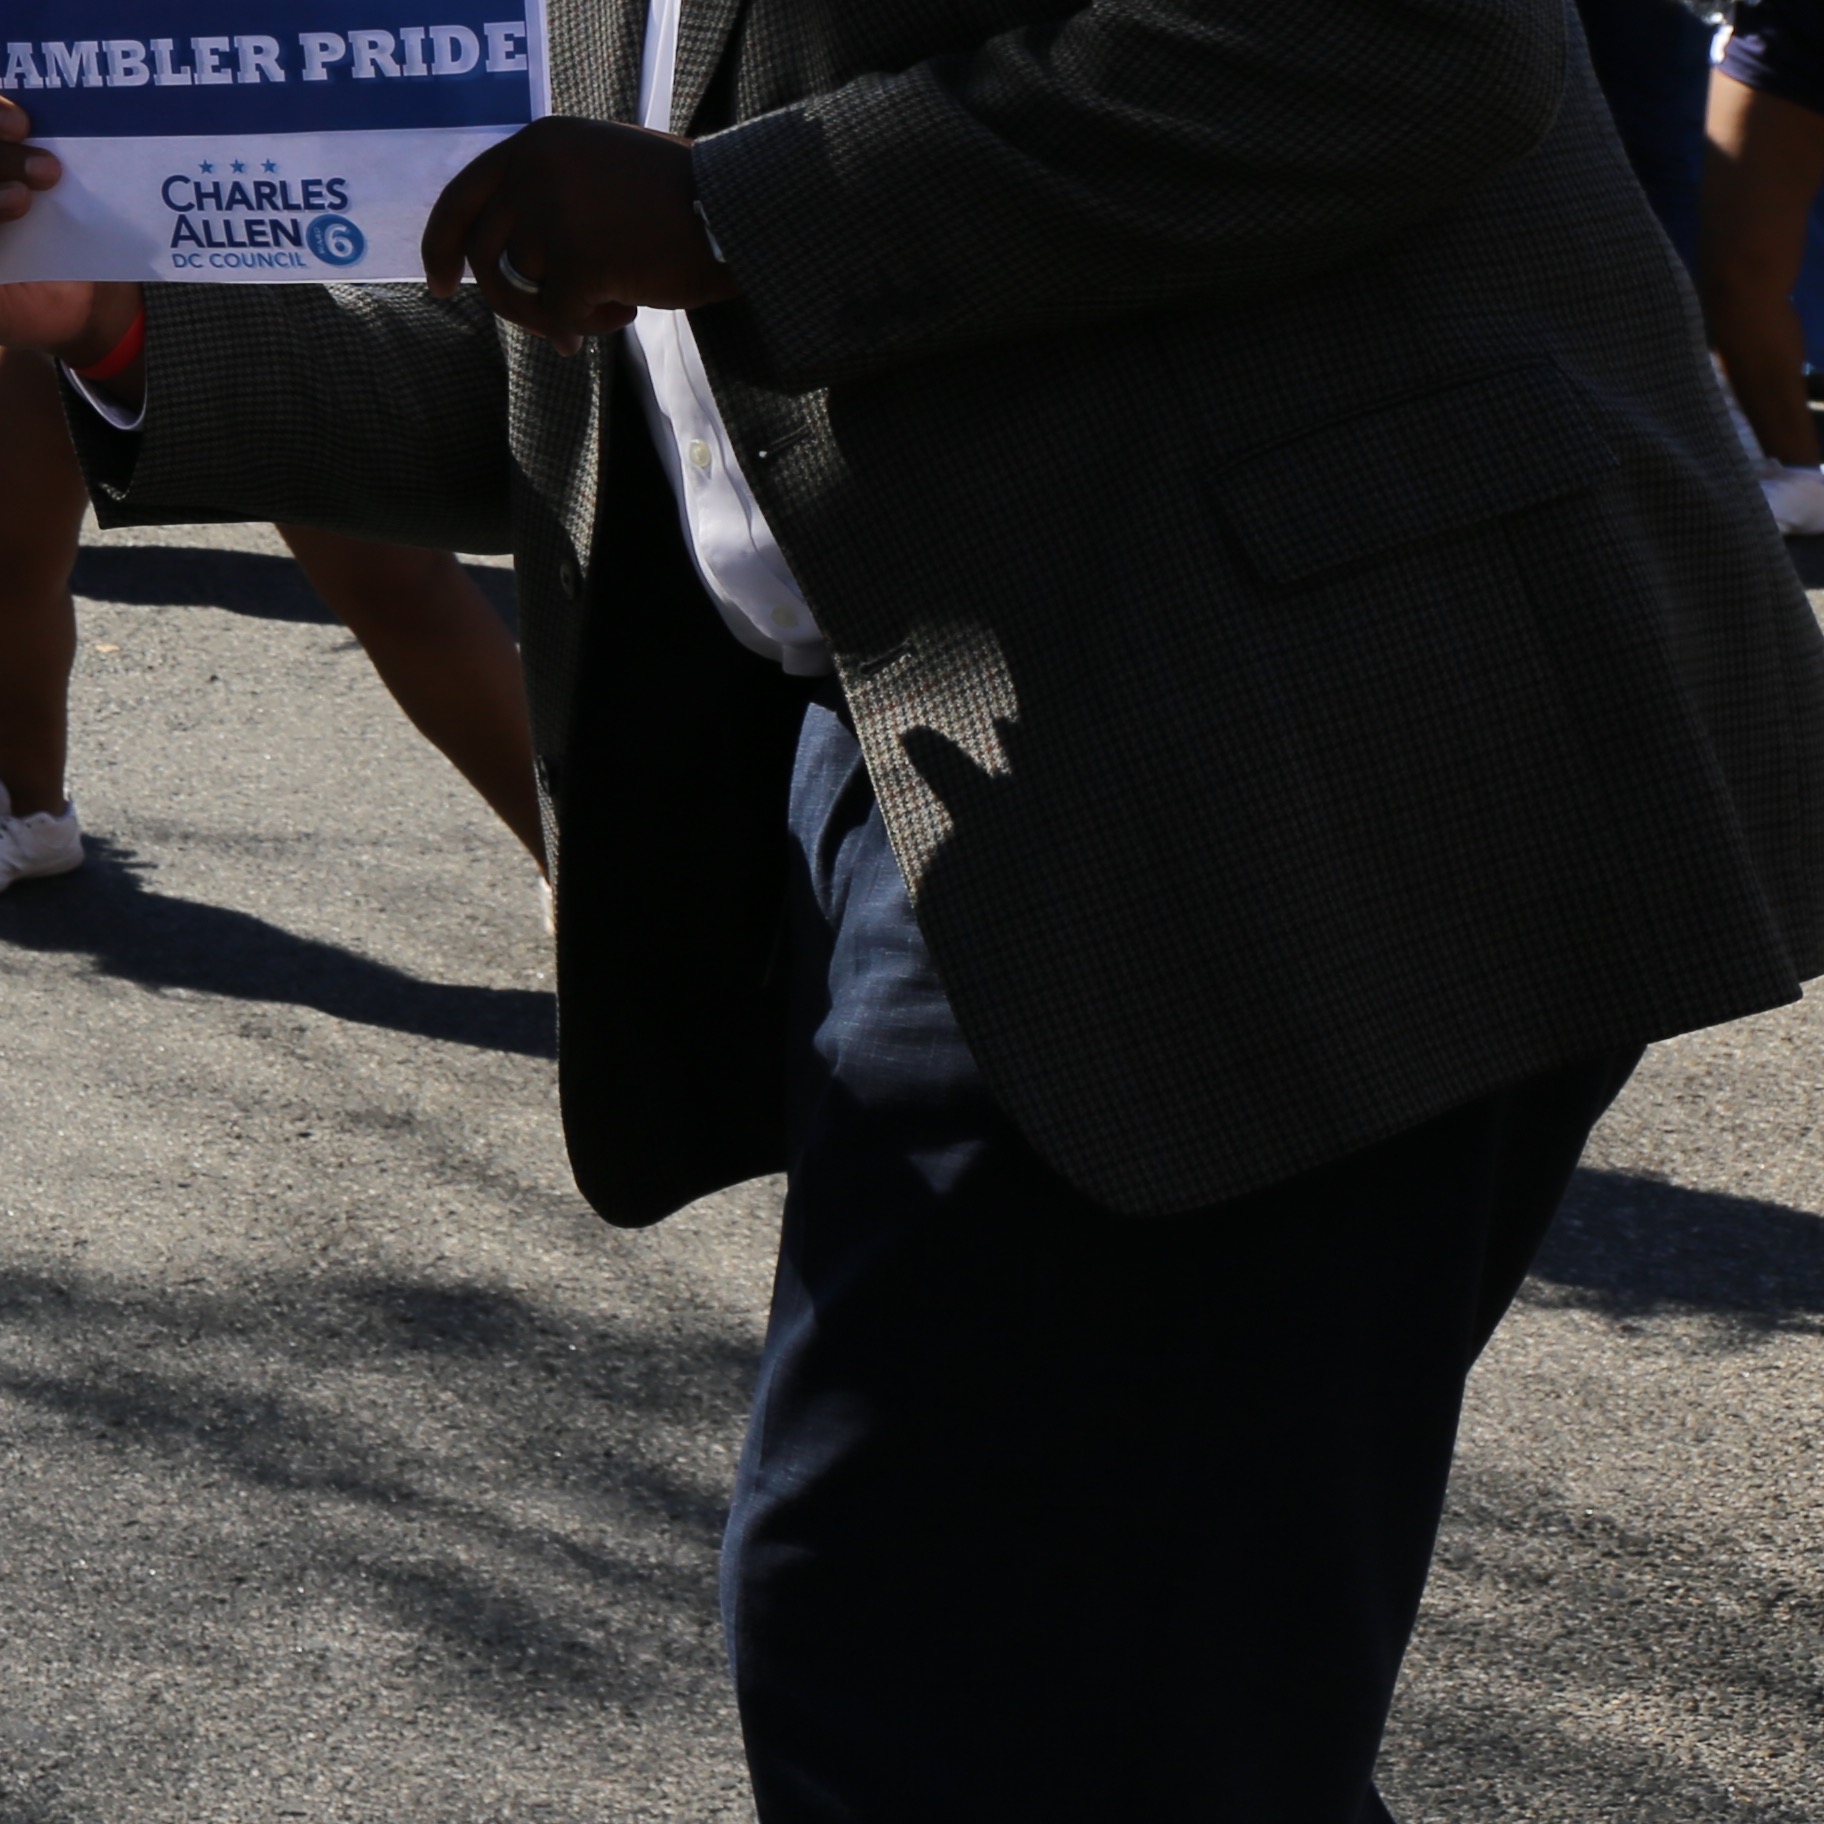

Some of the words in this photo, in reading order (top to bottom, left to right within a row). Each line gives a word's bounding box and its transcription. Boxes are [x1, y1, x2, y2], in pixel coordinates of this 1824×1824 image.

[299, 20, 528, 82] PRIDE
[162, 174, 349, 212] CHARLES
[171, 214, 303, 249] ALLEN
[324, 223, 354, 258] 6
[172, 253, 202, 268] DC
[209, 252, 306, 269] COUNCIL
